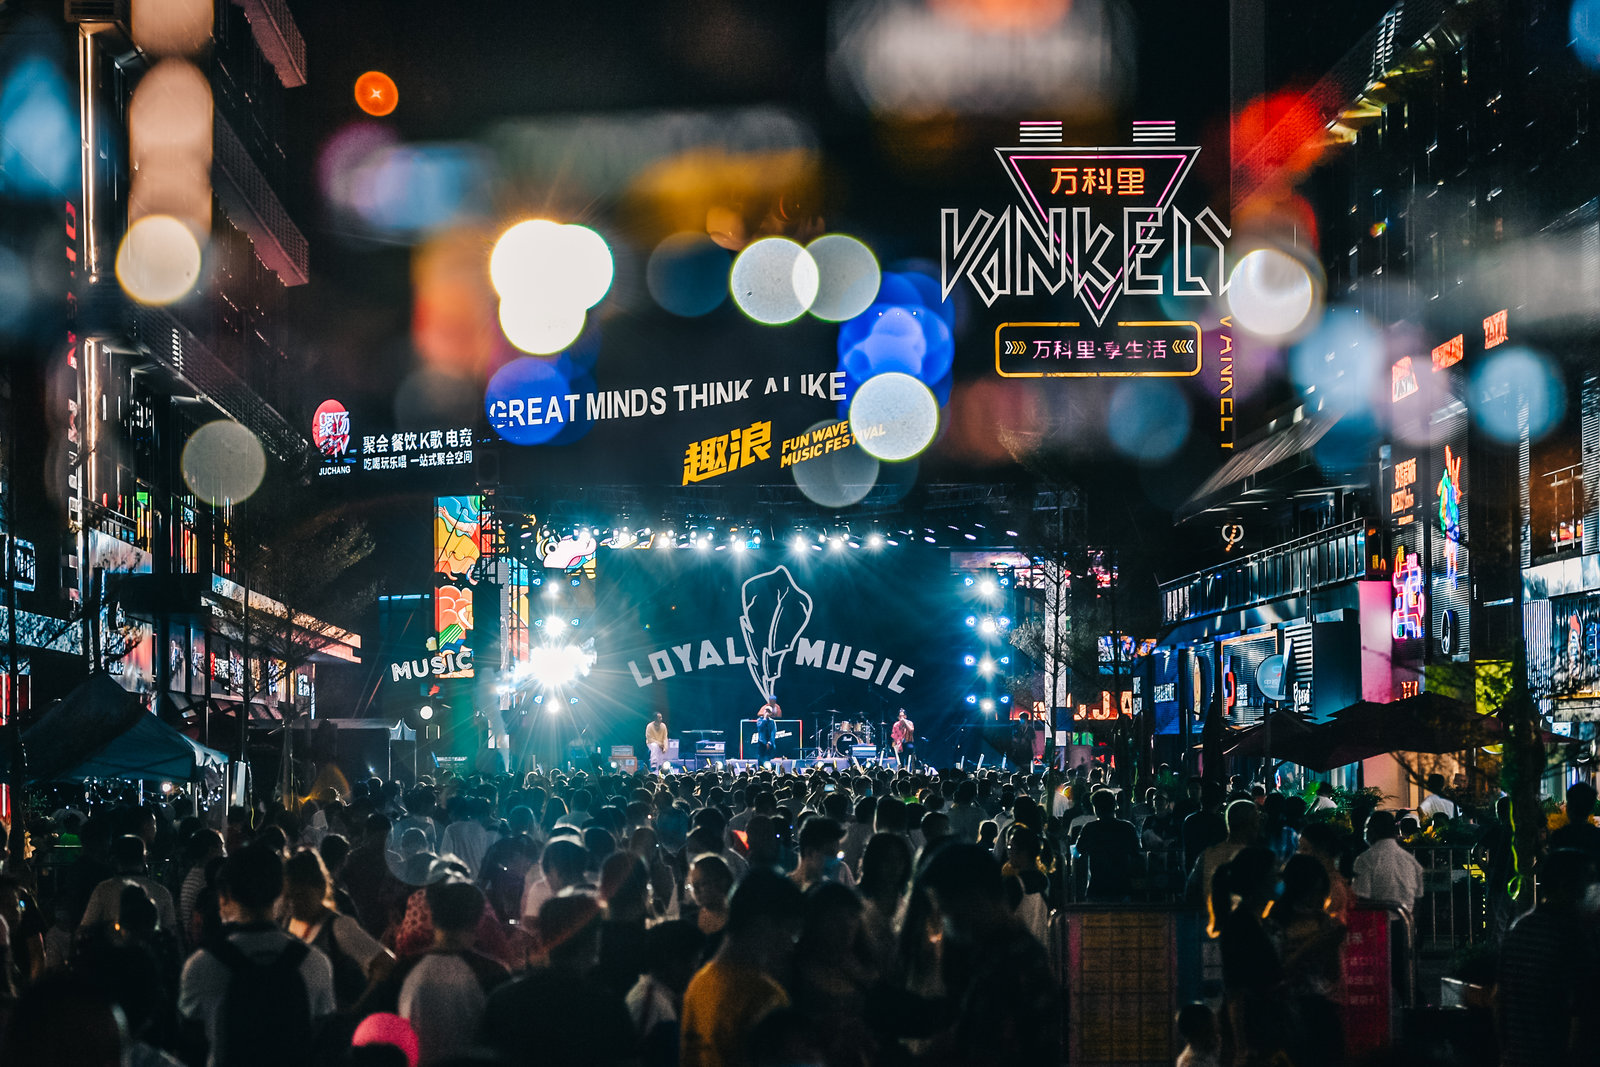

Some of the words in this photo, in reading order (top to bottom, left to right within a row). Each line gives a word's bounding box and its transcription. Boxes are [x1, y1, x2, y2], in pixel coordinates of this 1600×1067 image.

[1050, 167, 1146, 196] 万科里
[489, 396, 581, 429] GREAT
[586, 386, 667, 421] MINDS
[673, 378, 753, 412] THINK
[362, 434, 389, 454] 聚会
[391, 431, 418, 452] 餐饮
[419, 429, 443, 449] K歌
[445, 427, 473, 448] 电竞
[781, 433, 810, 454] FUN
[812, 420, 849, 443] WAVE
[363, 455, 407, 470] 吃喝玩乐唱
[410, 450, 473, 468] 一站式聚会空间
[682, 420, 772, 486] 趣浪
[780, 443, 824, 469] MUSIC
[318, 465, 351, 476] JUCHANG
[391, 651, 473, 682] MUSIC
[628, 637, 746, 688] LOYAL
[796, 639, 916, 694] MUSIC
